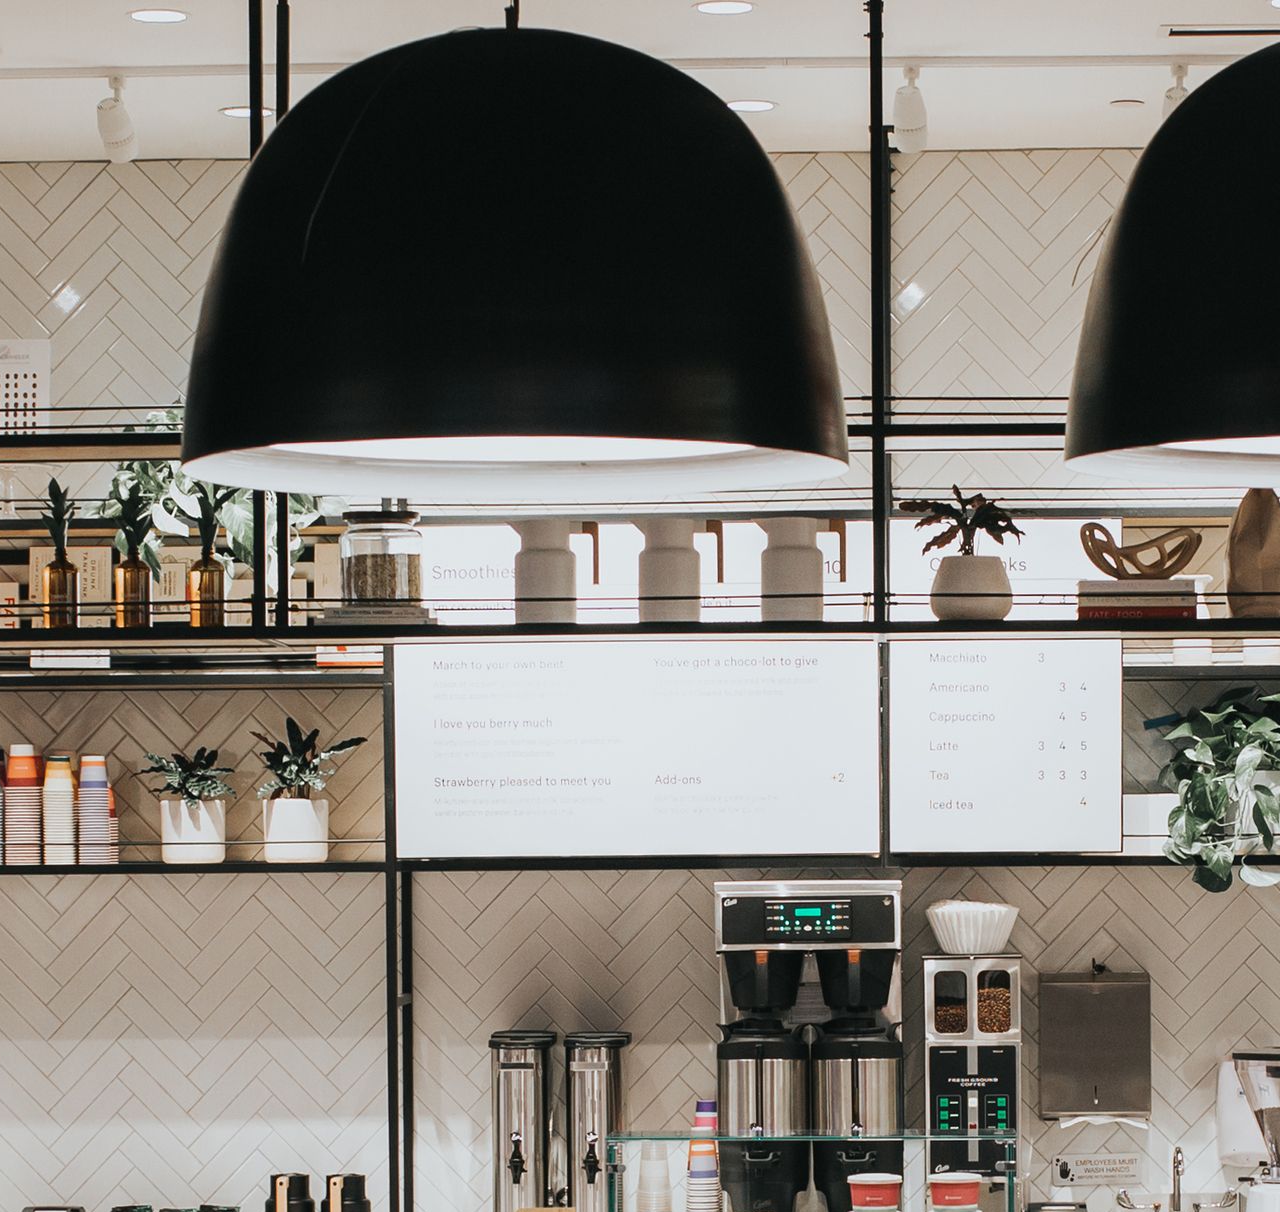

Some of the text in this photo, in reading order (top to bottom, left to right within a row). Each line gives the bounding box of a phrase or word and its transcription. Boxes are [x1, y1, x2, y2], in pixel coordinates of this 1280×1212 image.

[693, 657, 710, 669] got
[724, 656, 776, 667] choco-lot
[780, 656, 791, 667] to
[795, 655, 819, 668] give
[929, 653, 1045, 664] Macchiato 3
[432, 660, 468, 671] March
[471, 660, 482, 670] to
[929, 682, 1087, 693] Americano 3 4
[929, 711, 1087, 724] Cappuccino 4 5
[440, 718, 463, 728] love
[466, 720, 486, 731] you
[489, 718, 519, 730] berry
[522, 717, 553, 728] much
[929, 740, 1088, 751] Latte 3 4 5
[654, 774, 702, 786] Add-ons
[929, 769, 1087, 780] Tea 3 3 3
[433, 776, 612, 789] Strawberry pleased to meet you
[929, 796, 1087, 810] Iced tea 4
[1074, 1159, 1117, 1167] EMPLOYEES
